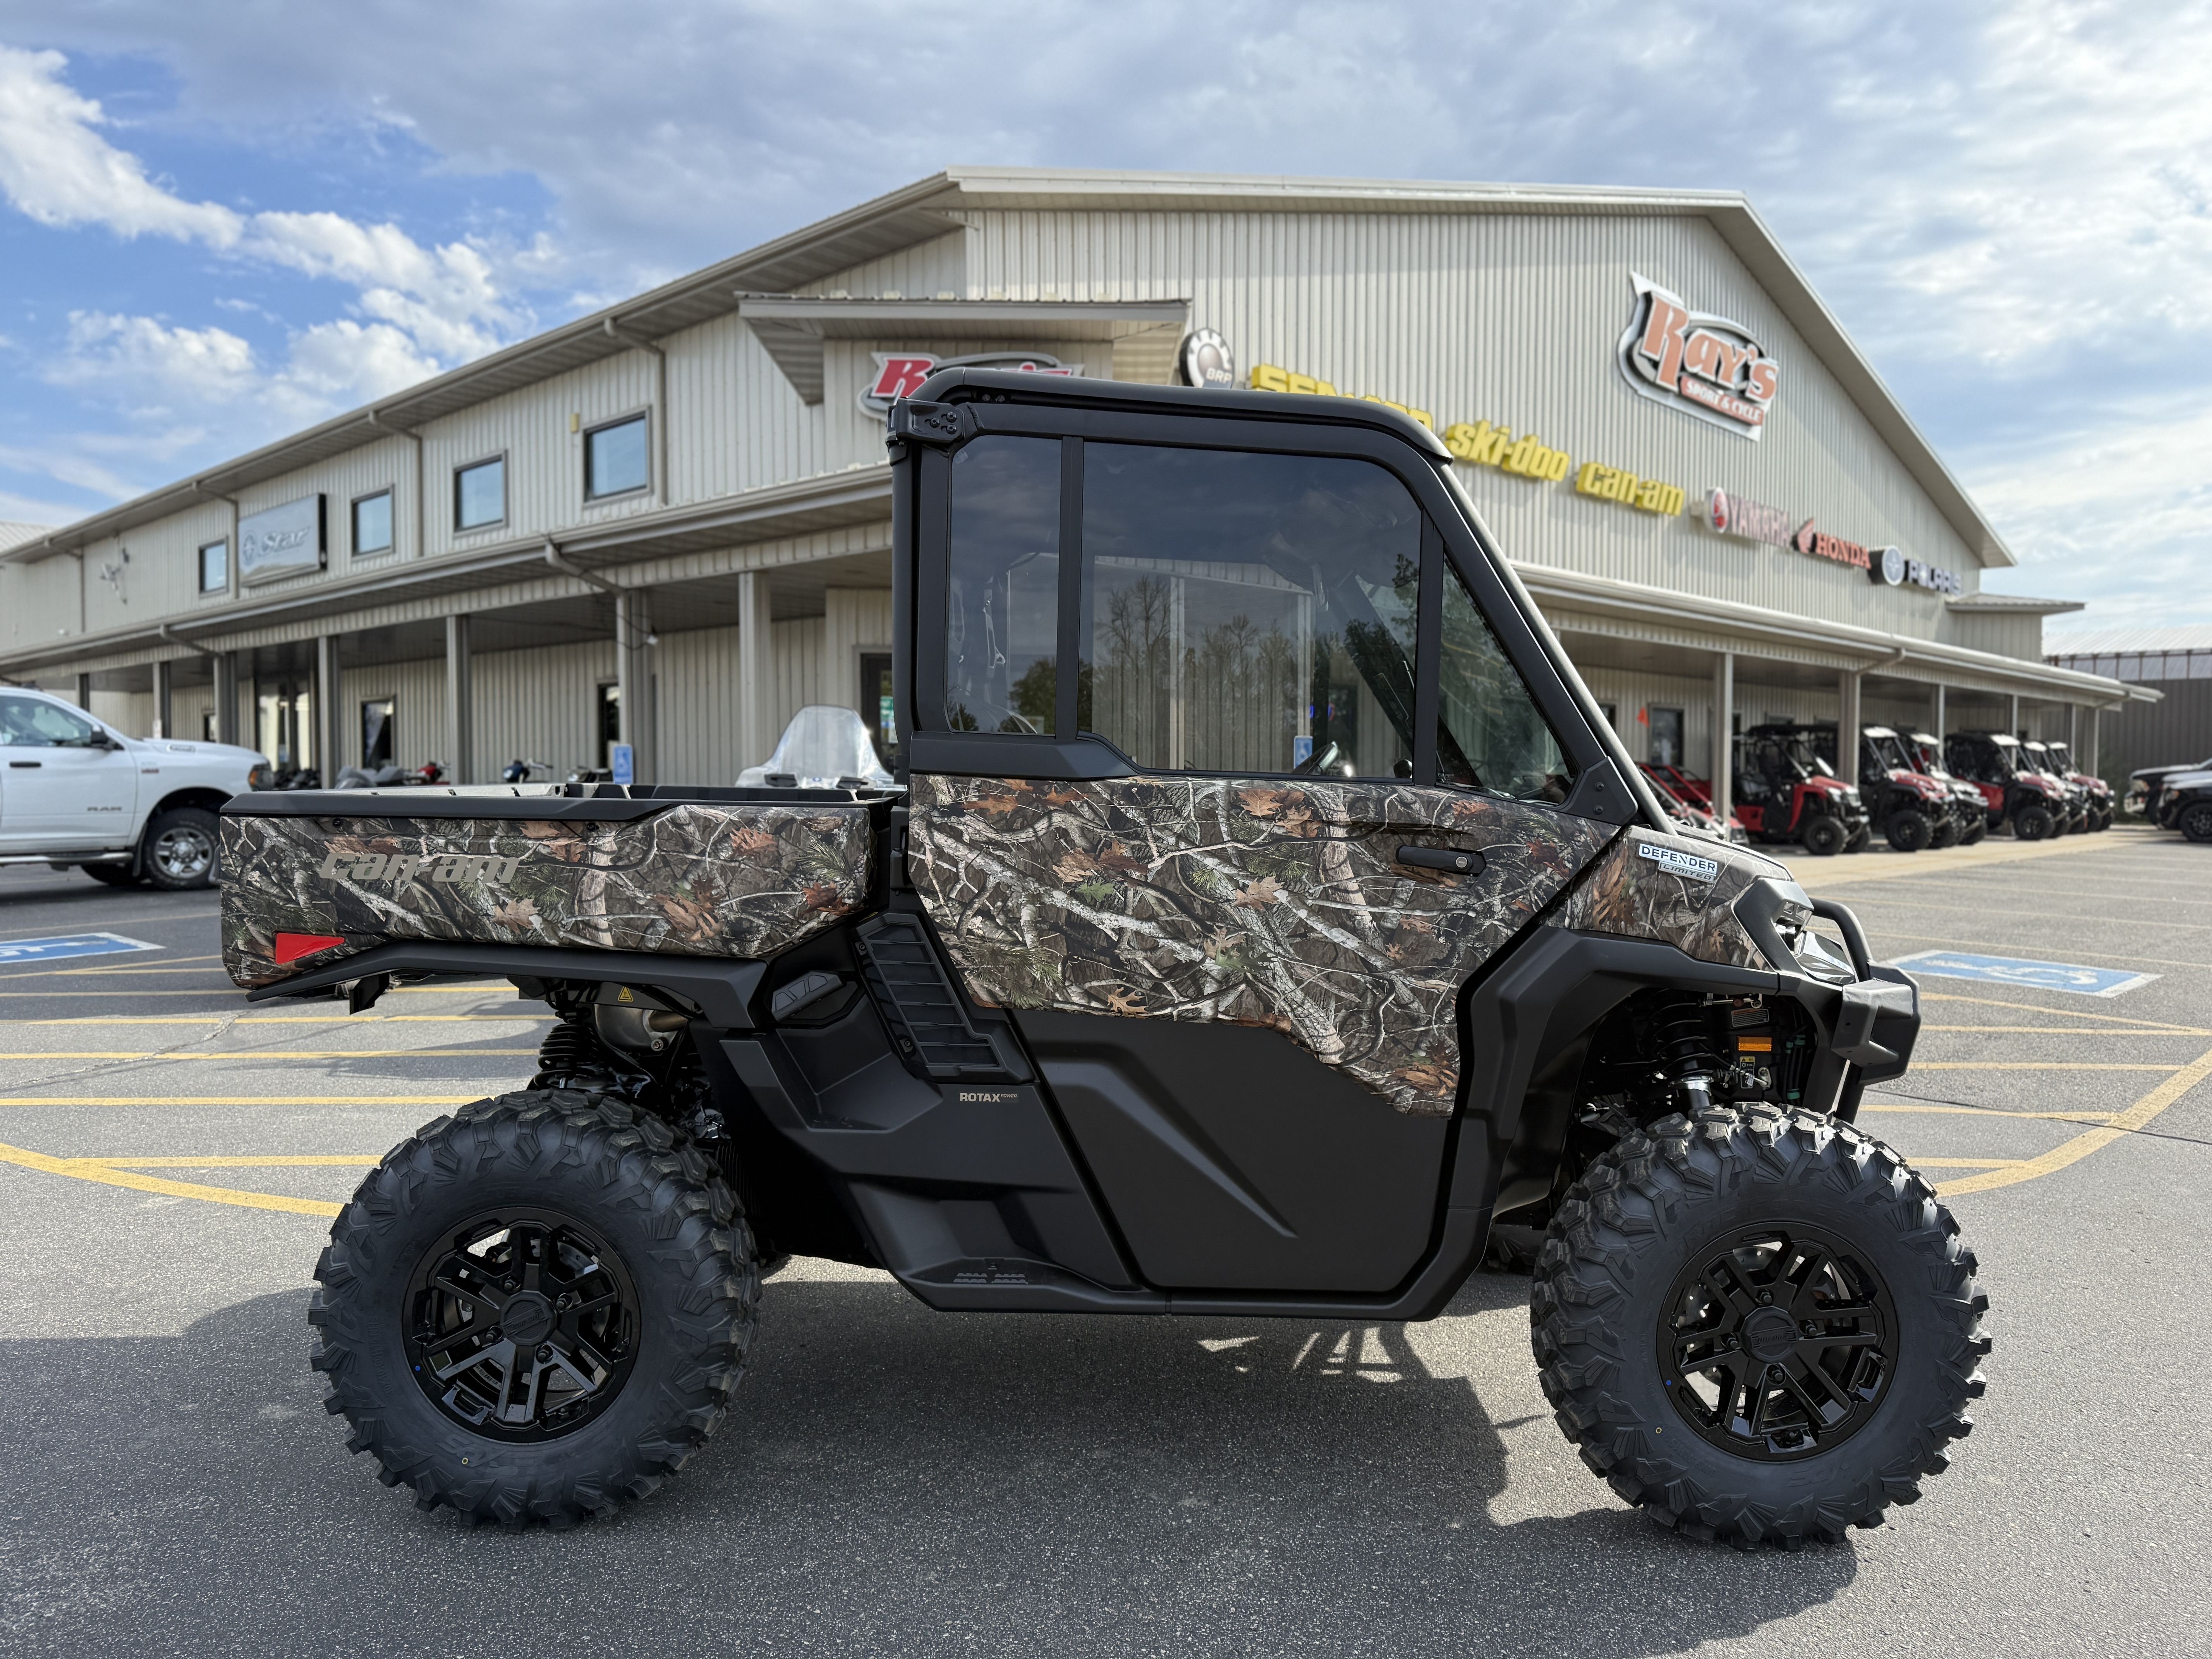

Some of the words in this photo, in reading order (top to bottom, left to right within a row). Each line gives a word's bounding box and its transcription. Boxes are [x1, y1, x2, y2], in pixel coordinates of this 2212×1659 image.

[1640, 291, 1778, 403] Ray's
[1206, 368, 1232, 384] BRP
[1685, 380, 1721, 405] SPORT
[1721, 396, 1730, 410] &
[1731, 401, 1761, 422] CYCLE
[1446, 420, 1570, 482] ski-doo
[1729, 493, 1790, 549] YAMAHA
[1815, 533, 1871, 569] HONDA
[1909, 559, 1963, 596] POLARIS
[1642, 846, 1716, 872] DEFENDER
[1663, 865, 1711, 880] LIMITED
[960, 1093, 1000, 1102] ROTAX
